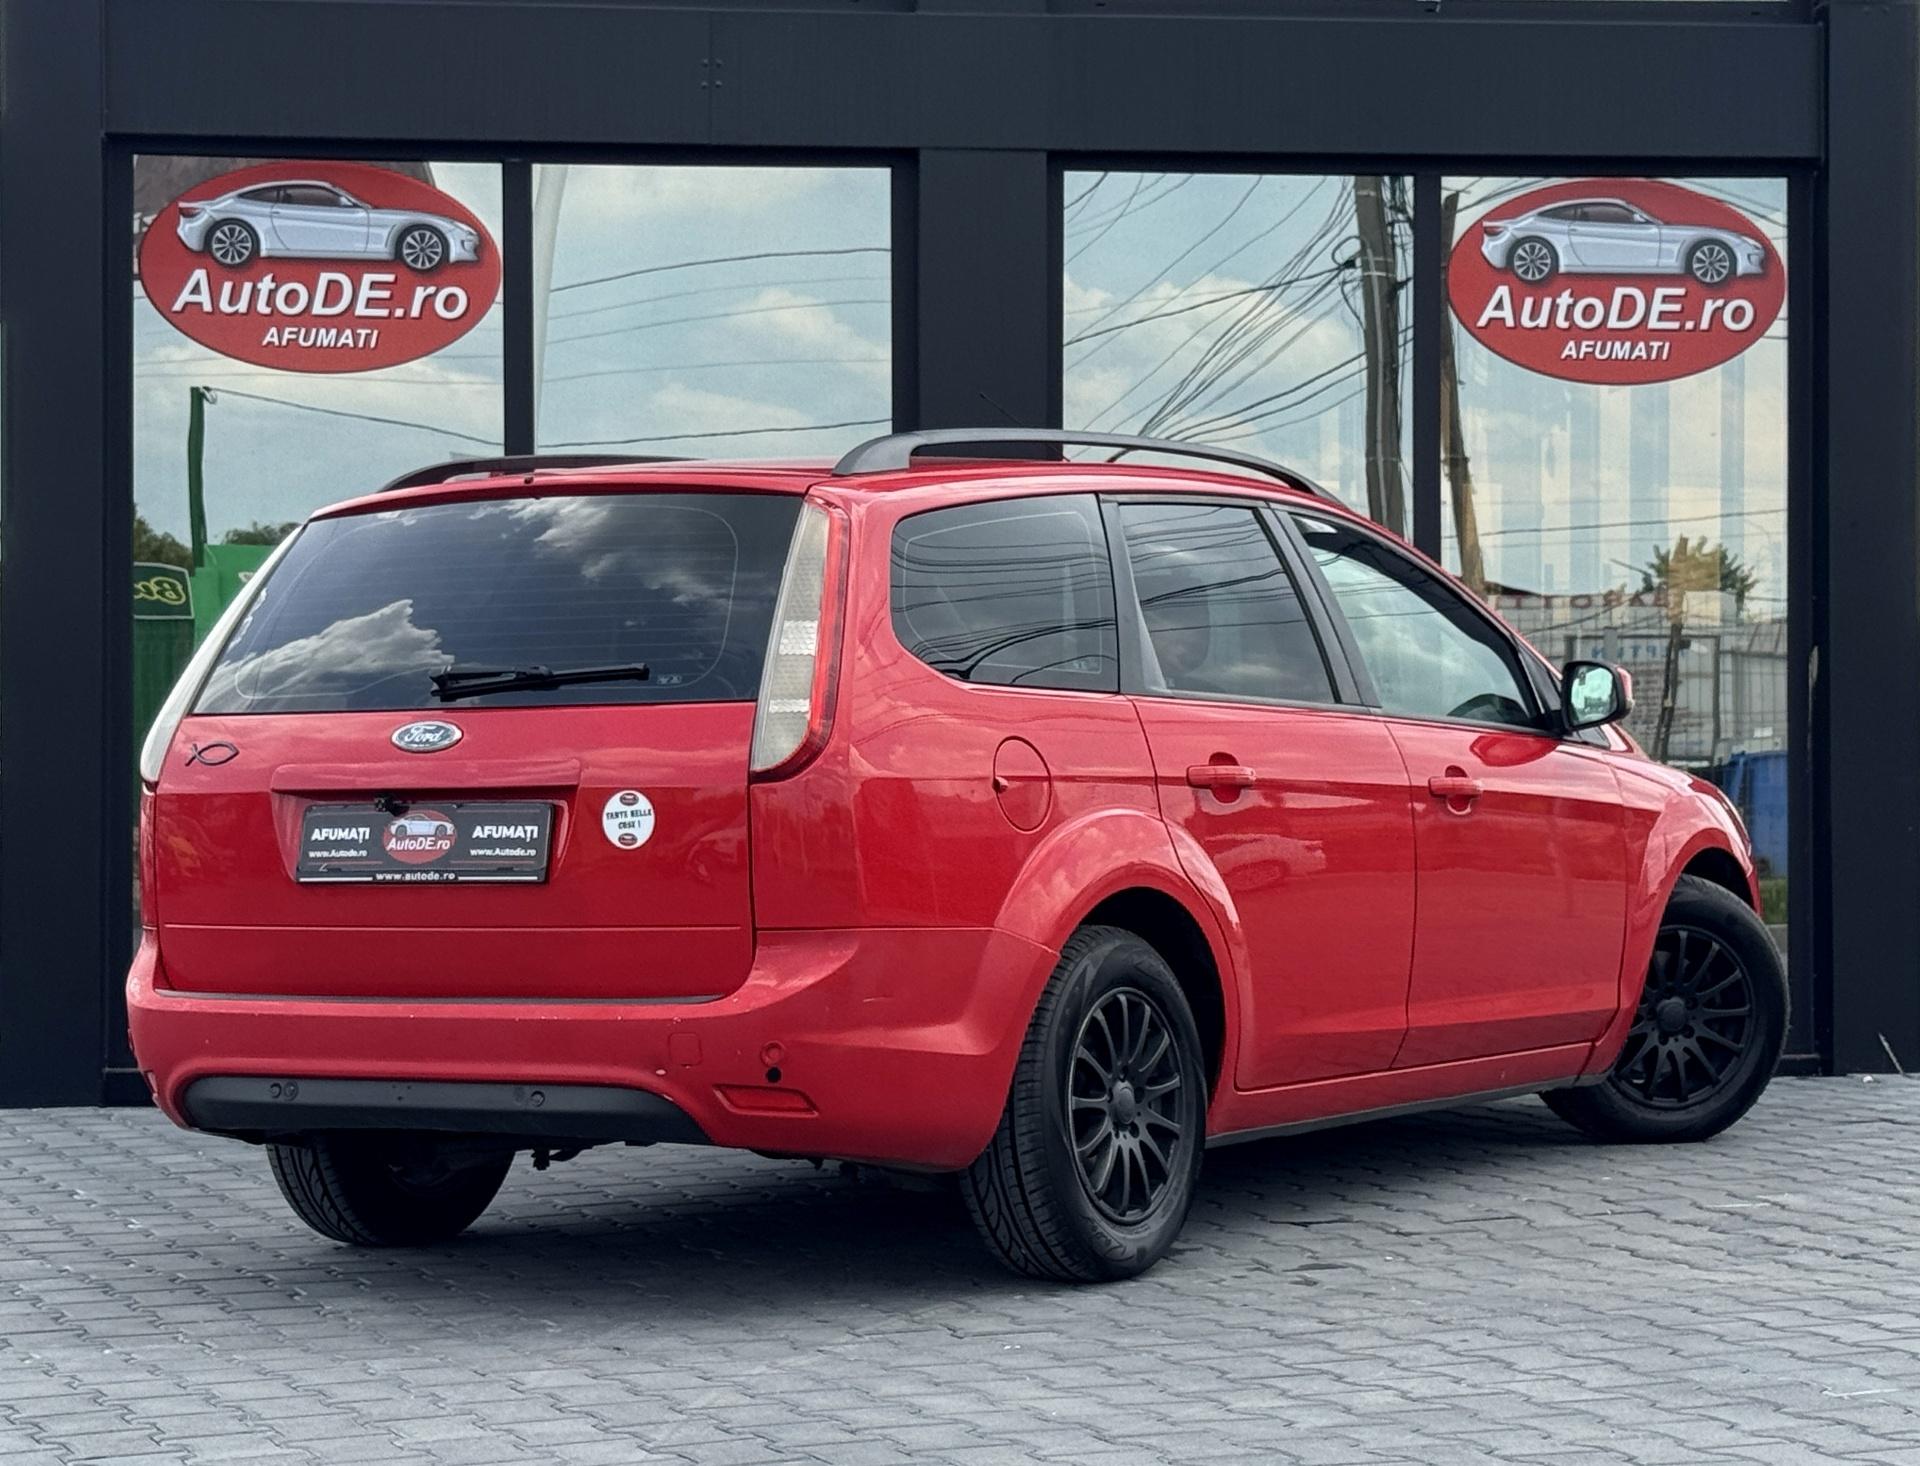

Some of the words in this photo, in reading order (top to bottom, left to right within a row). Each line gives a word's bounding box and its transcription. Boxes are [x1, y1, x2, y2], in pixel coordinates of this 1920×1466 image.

[171, 268, 468, 320] AutoDE.ro
[1476, 285, 1755, 332] AutoDE.ro
[262, 326, 379, 349] AFUMATI
[1560, 340, 1670, 361] AFUMATI
[404, 725, 445, 743] Ford
[386, 836, 451, 851] AutoDE.ro
[376, 871, 456, 880] www.autode.ro
